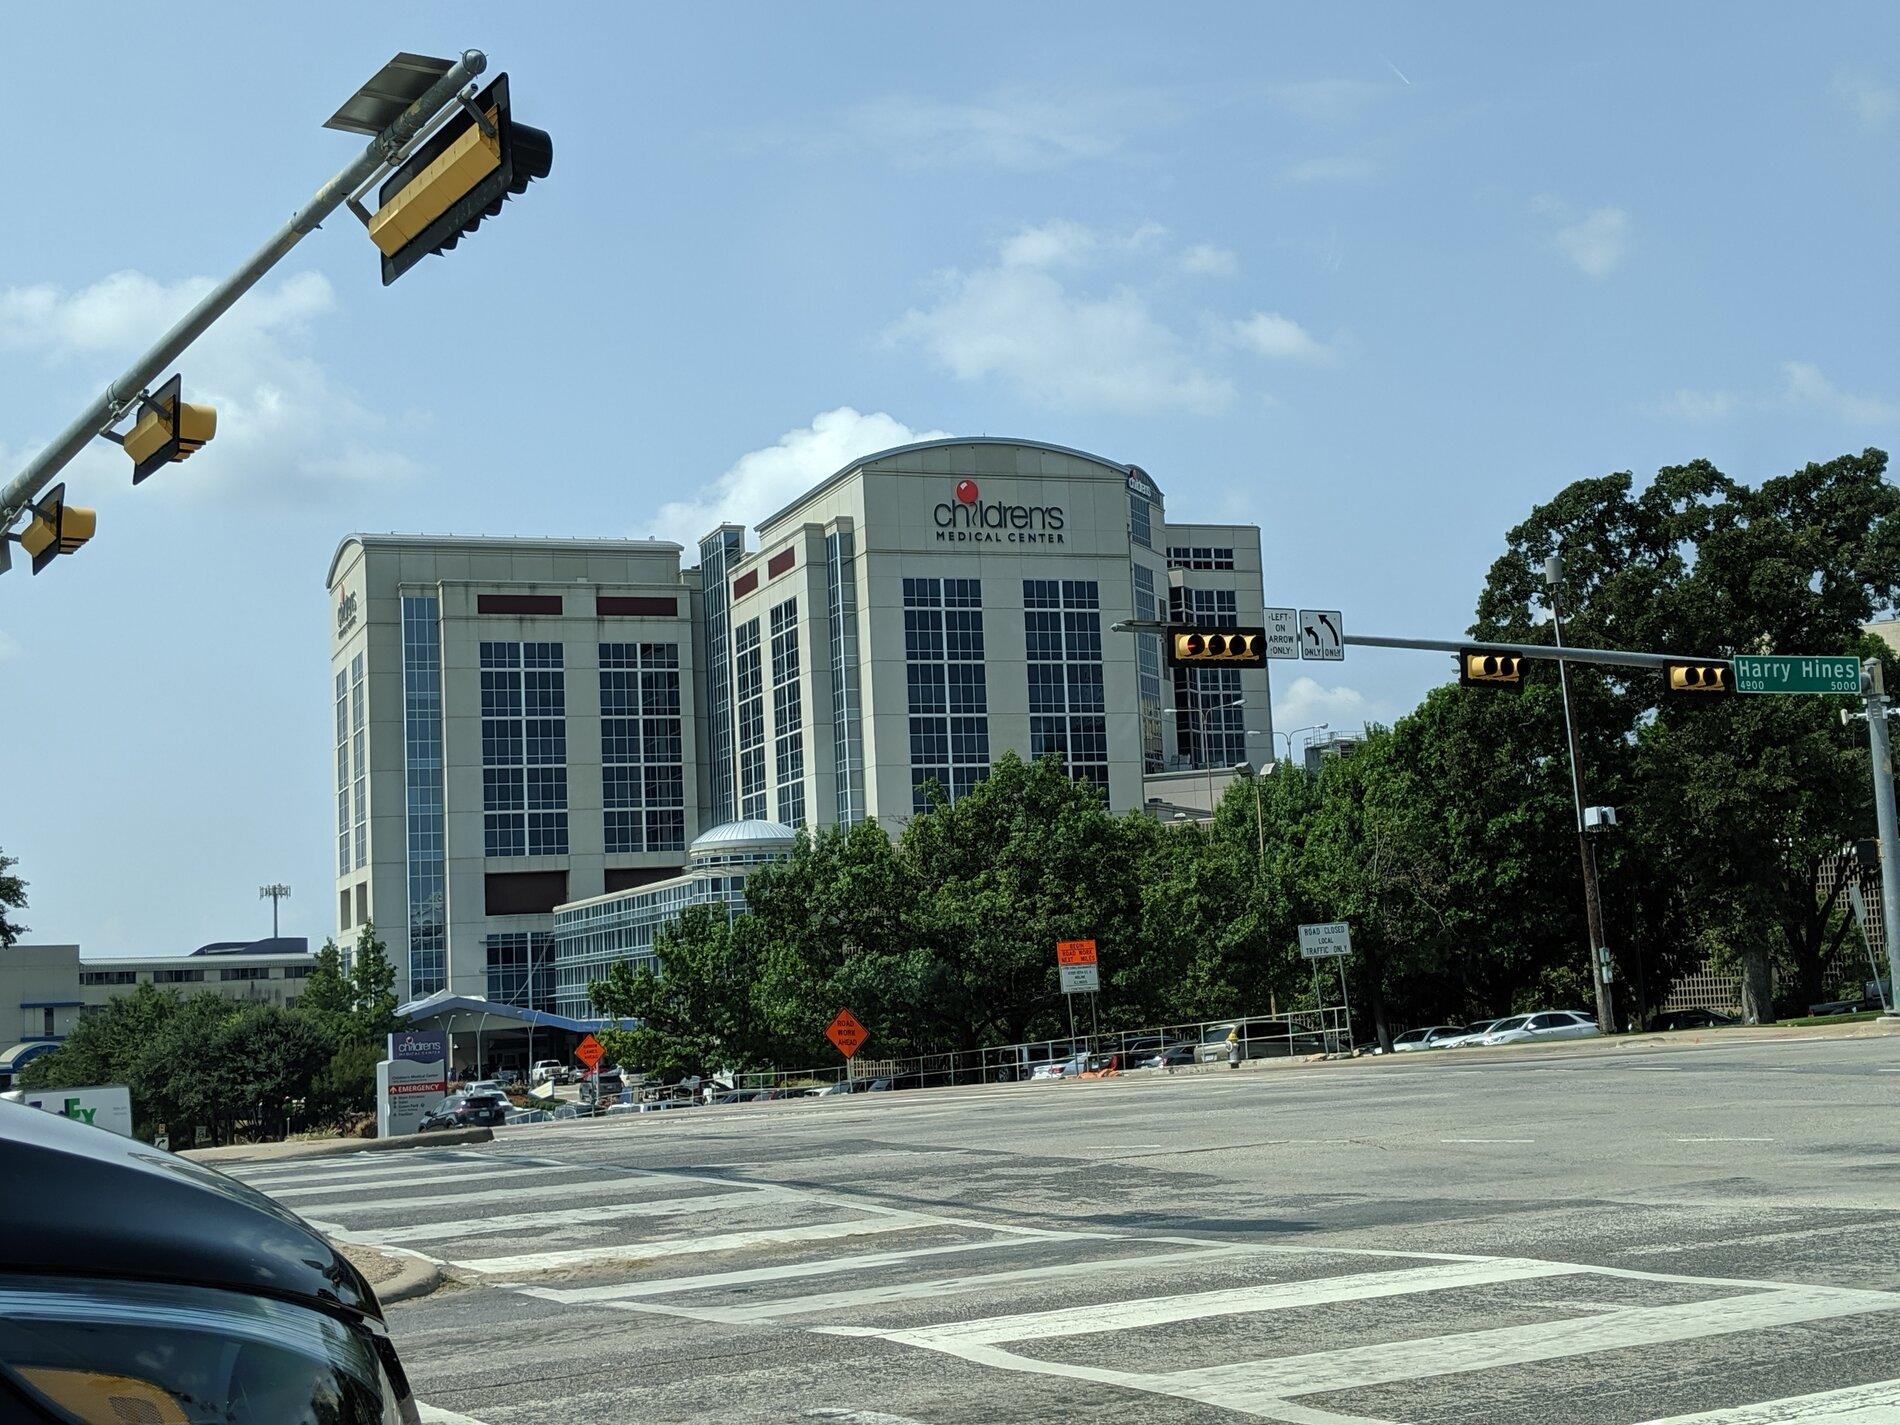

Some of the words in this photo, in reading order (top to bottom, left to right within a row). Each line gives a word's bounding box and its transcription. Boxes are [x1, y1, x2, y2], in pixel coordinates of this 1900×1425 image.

[936, 531, 1001, 542] MEDICAL
[1008, 533, 1064, 543] CENTER
[1271, 613, 1288, 621] LEFT
[1275, 624, 1286, 632] ON
[1268, 635, 1294, 643] ARROW
[1272, 646, 1290, 654] ONLY
[1304, 648, 1321, 656] ONLY
[1325, 648, 1341, 657] ONLY
[1740, 660, 1791, 682] Harry
[1802, 660, 1855, 678] Hines
[1740, 680, 1764, 690] 4900
[1831, 681, 1857, 691] 5000
[1304, 928, 1320, 936] ROAD
[1324, 925, 1345, 935] CLOSED
[1306, 946, 1329, 955] TRAFFIC
[1333, 945, 1347, 953] ONLY
[398, 1084, 439, 1092] EMERGENCY
